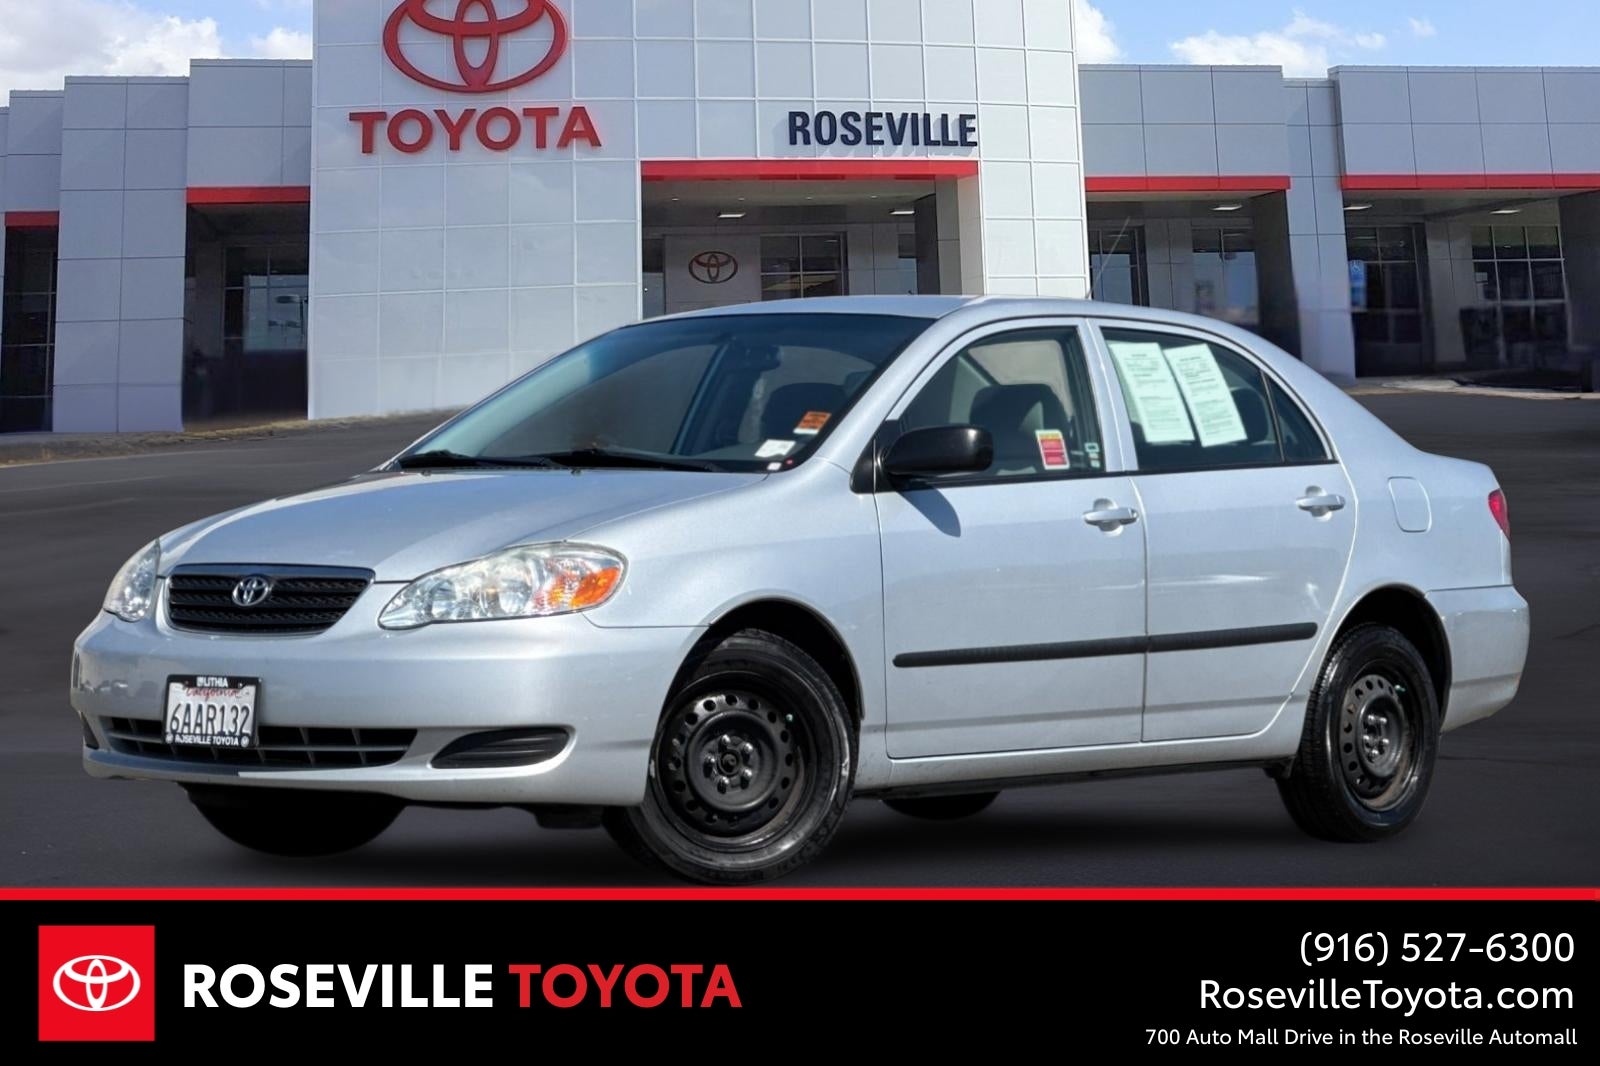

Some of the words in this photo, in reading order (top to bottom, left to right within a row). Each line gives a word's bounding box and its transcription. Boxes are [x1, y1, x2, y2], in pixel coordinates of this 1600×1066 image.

[349, 106, 602, 154] TOYOTA
[788, 110, 979, 148] ROSEVILLE
[170, 703, 250, 737] 6AAR132
[175, 735, 211, 745] ROSEVILLE
[213, 736, 239, 746] TOYOTA
